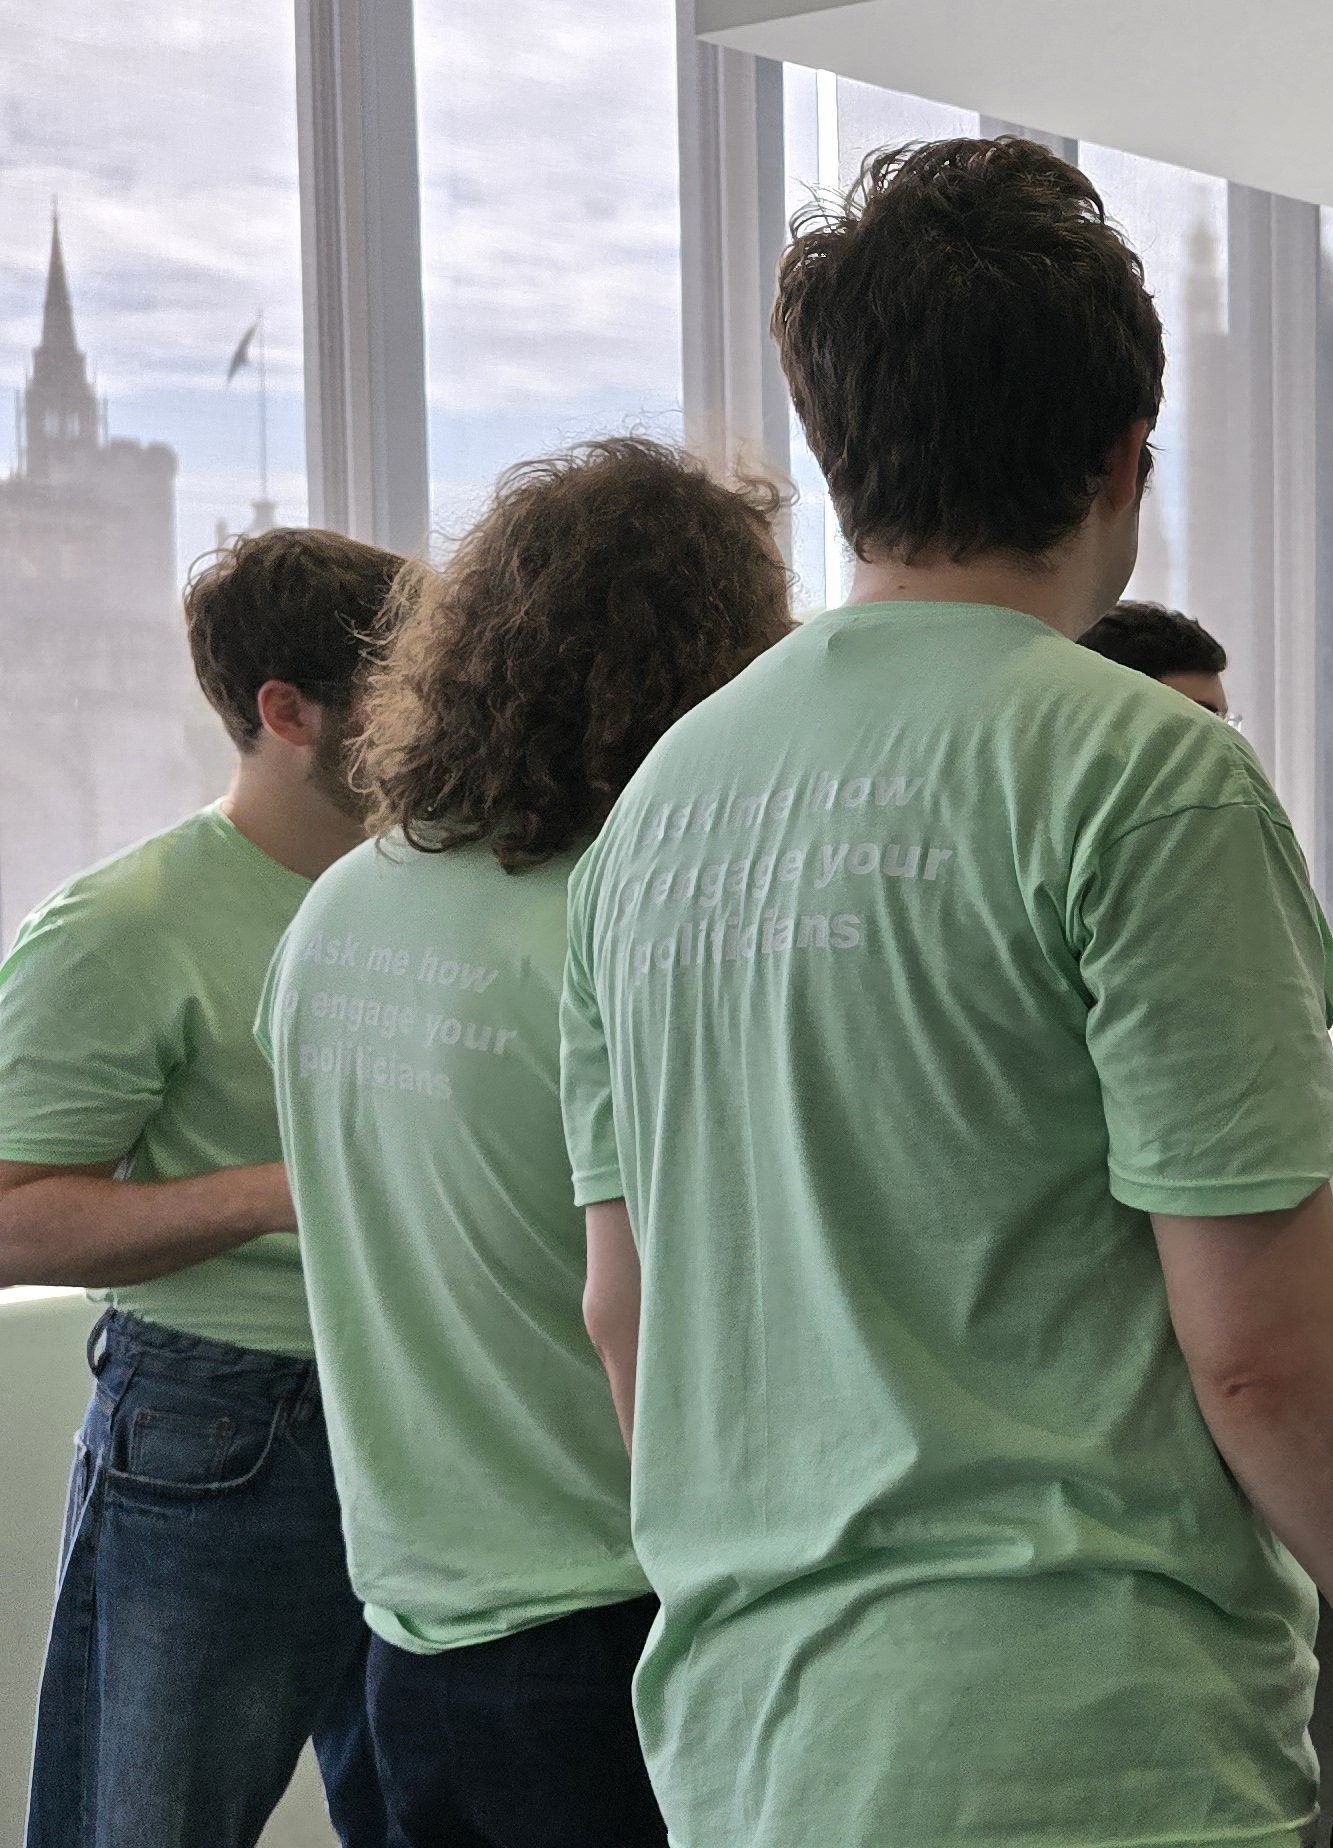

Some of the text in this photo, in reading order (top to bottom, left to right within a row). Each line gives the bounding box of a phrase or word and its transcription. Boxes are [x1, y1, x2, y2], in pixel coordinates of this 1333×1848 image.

[730, 787, 796, 828] me
[810, 771, 925, 813] how
[651, 848, 805, 908] engage
[814, 842, 952, 889] your
[302, 931, 499, 993] Ask me how
[311, 990, 416, 1039] engage
[423, 1013, 517, 1055] your
